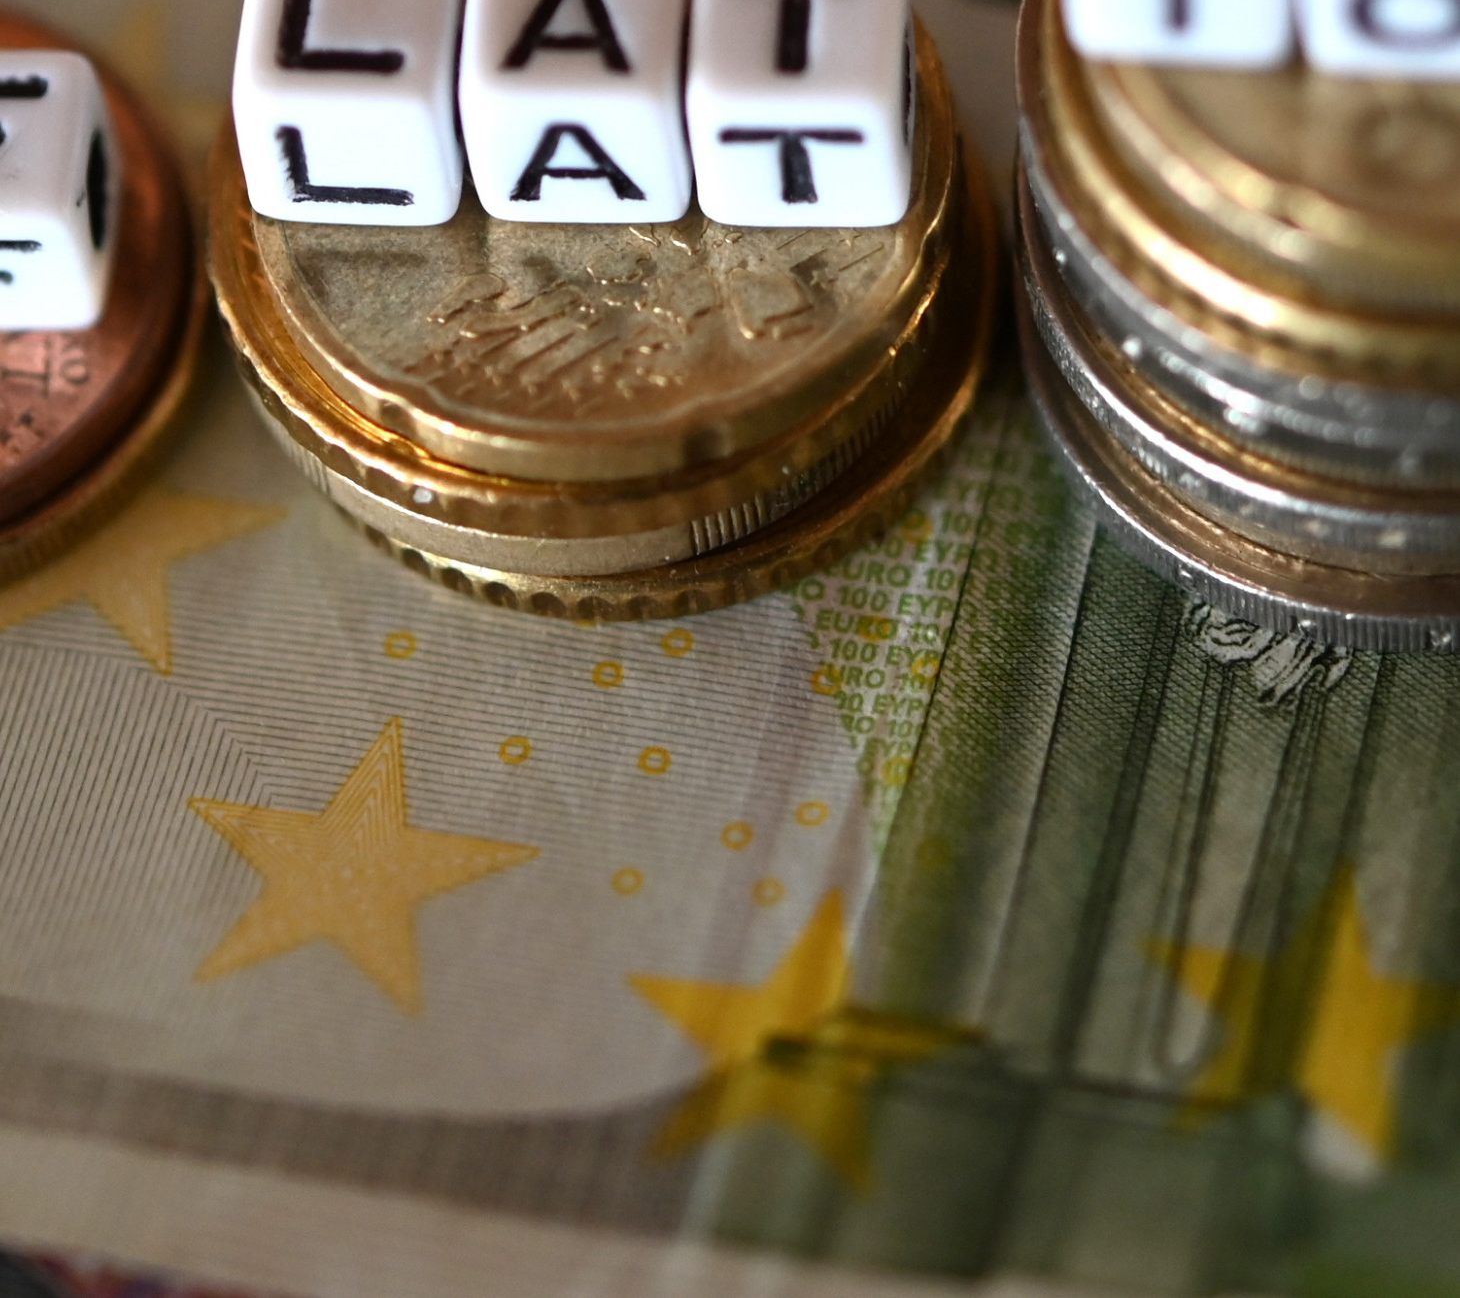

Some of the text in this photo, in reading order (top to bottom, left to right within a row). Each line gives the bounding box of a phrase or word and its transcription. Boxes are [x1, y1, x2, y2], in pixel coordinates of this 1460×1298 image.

[274, 123, 865, 206] LAT
[837, 584, 889, 613] 100
[816, 608, 897, 640] EURO
[829, 638, 879, 665] 100
